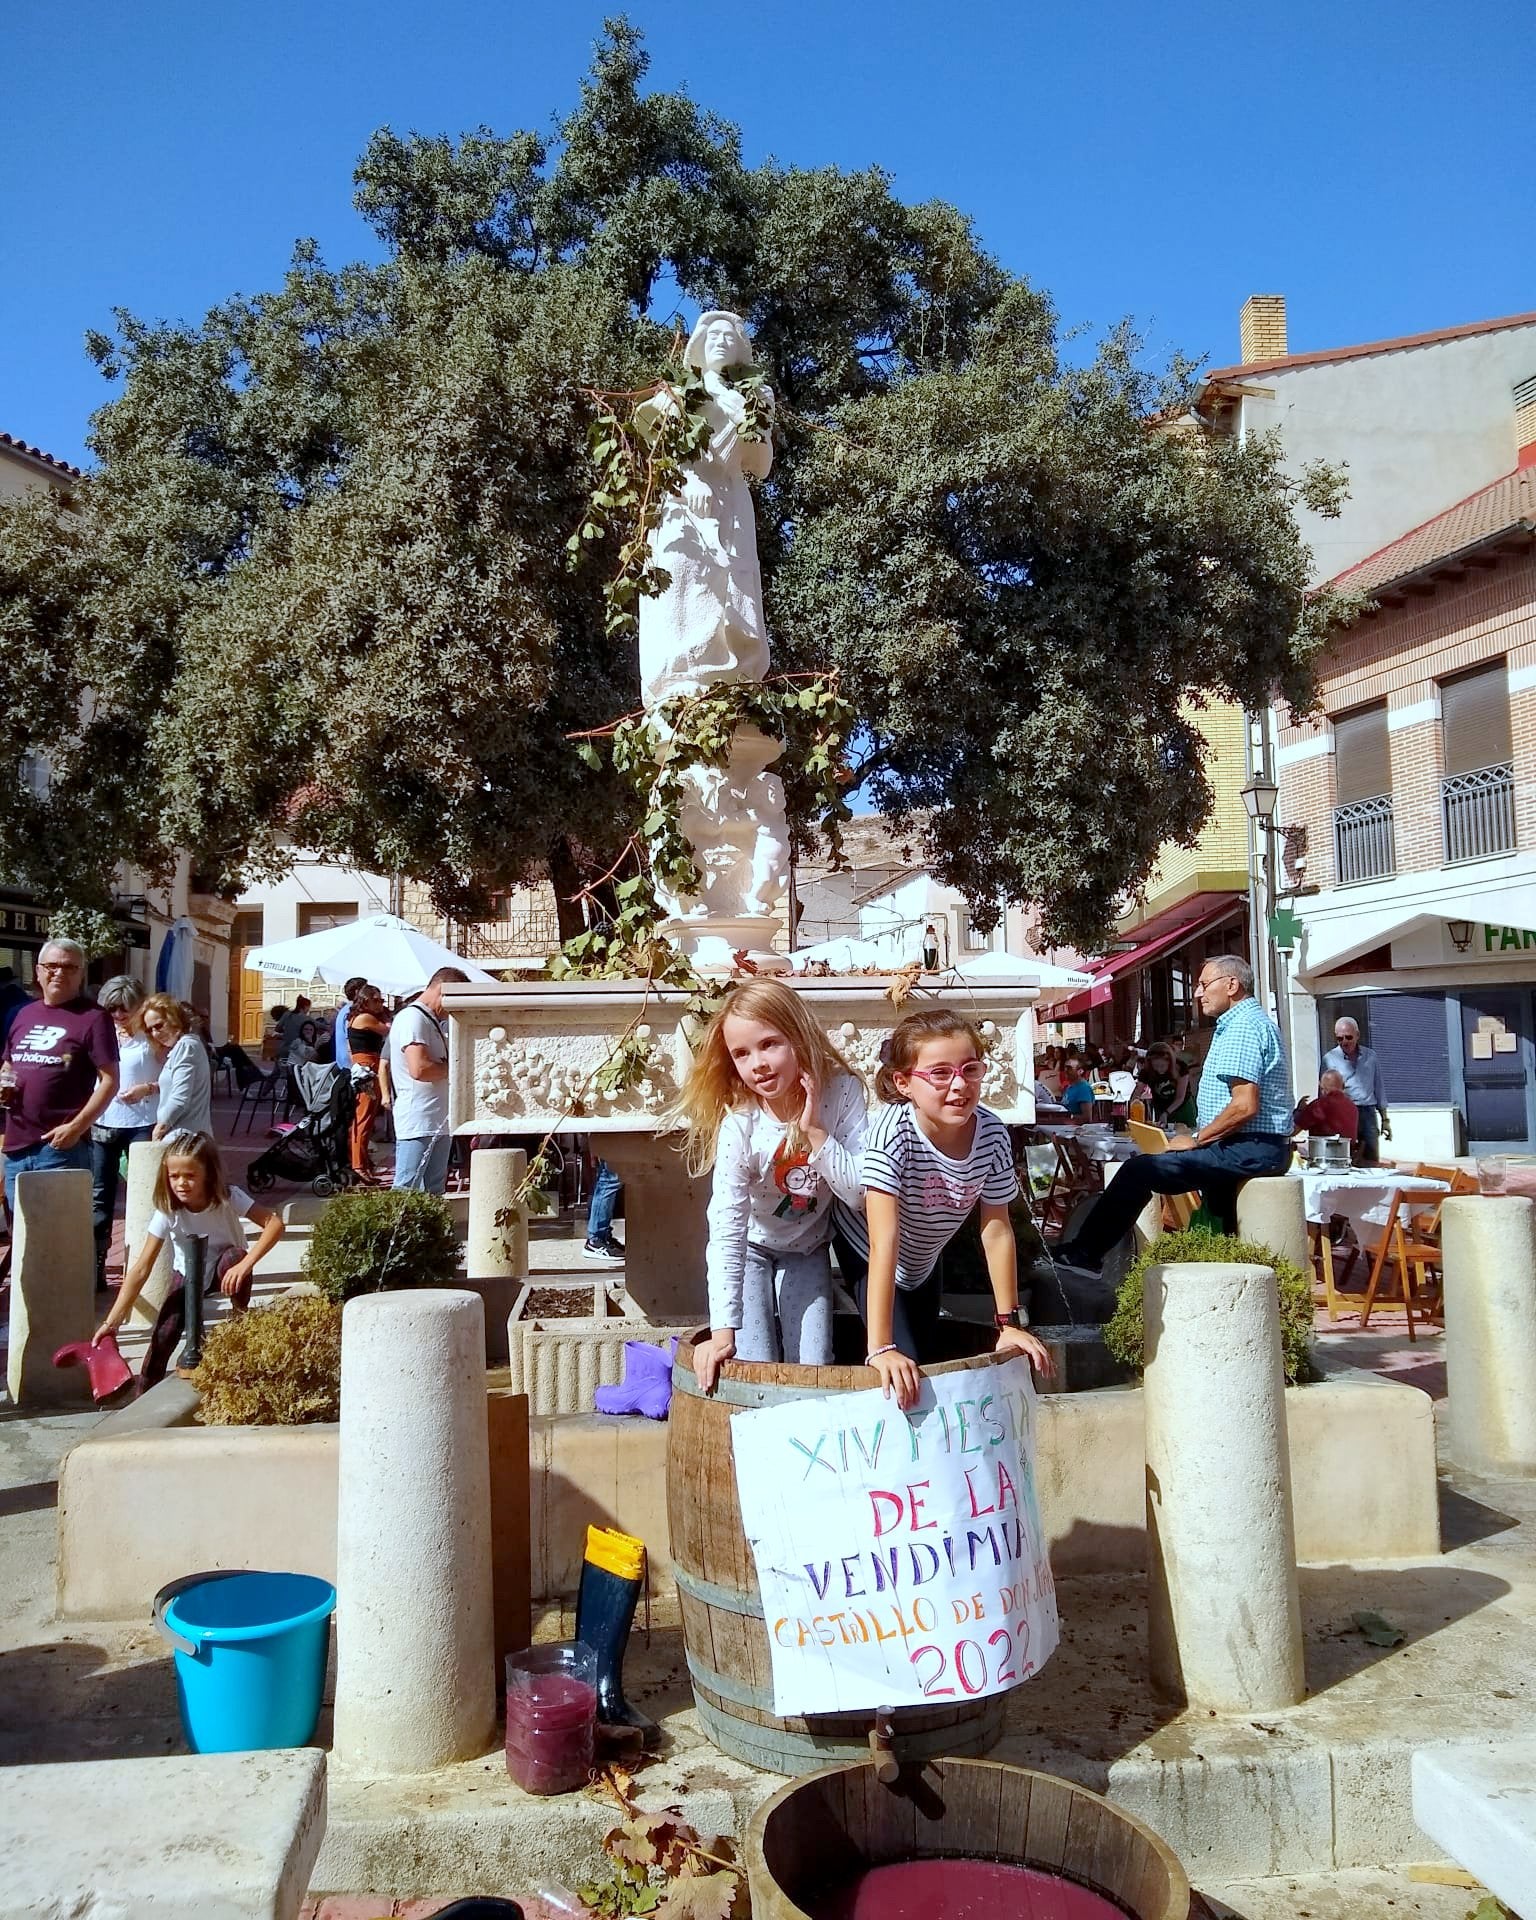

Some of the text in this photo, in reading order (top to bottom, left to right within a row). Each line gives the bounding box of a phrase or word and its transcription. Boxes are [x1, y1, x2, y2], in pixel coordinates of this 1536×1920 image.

[14, 912, 27, 932] EL
[263, 962, 286, 972] ESTRELLA
[23, 1052, 63, 1064] balance
[788, 1389, 1031, 1482] XIV FIESTA
[868, 1460, 1018, 1538] DE LA
[803, 1517, 1028, 1601] VENDIMIA
[951, 1592, 986, 1625] DE
[910, 1619, 1035, 1697] 2022
